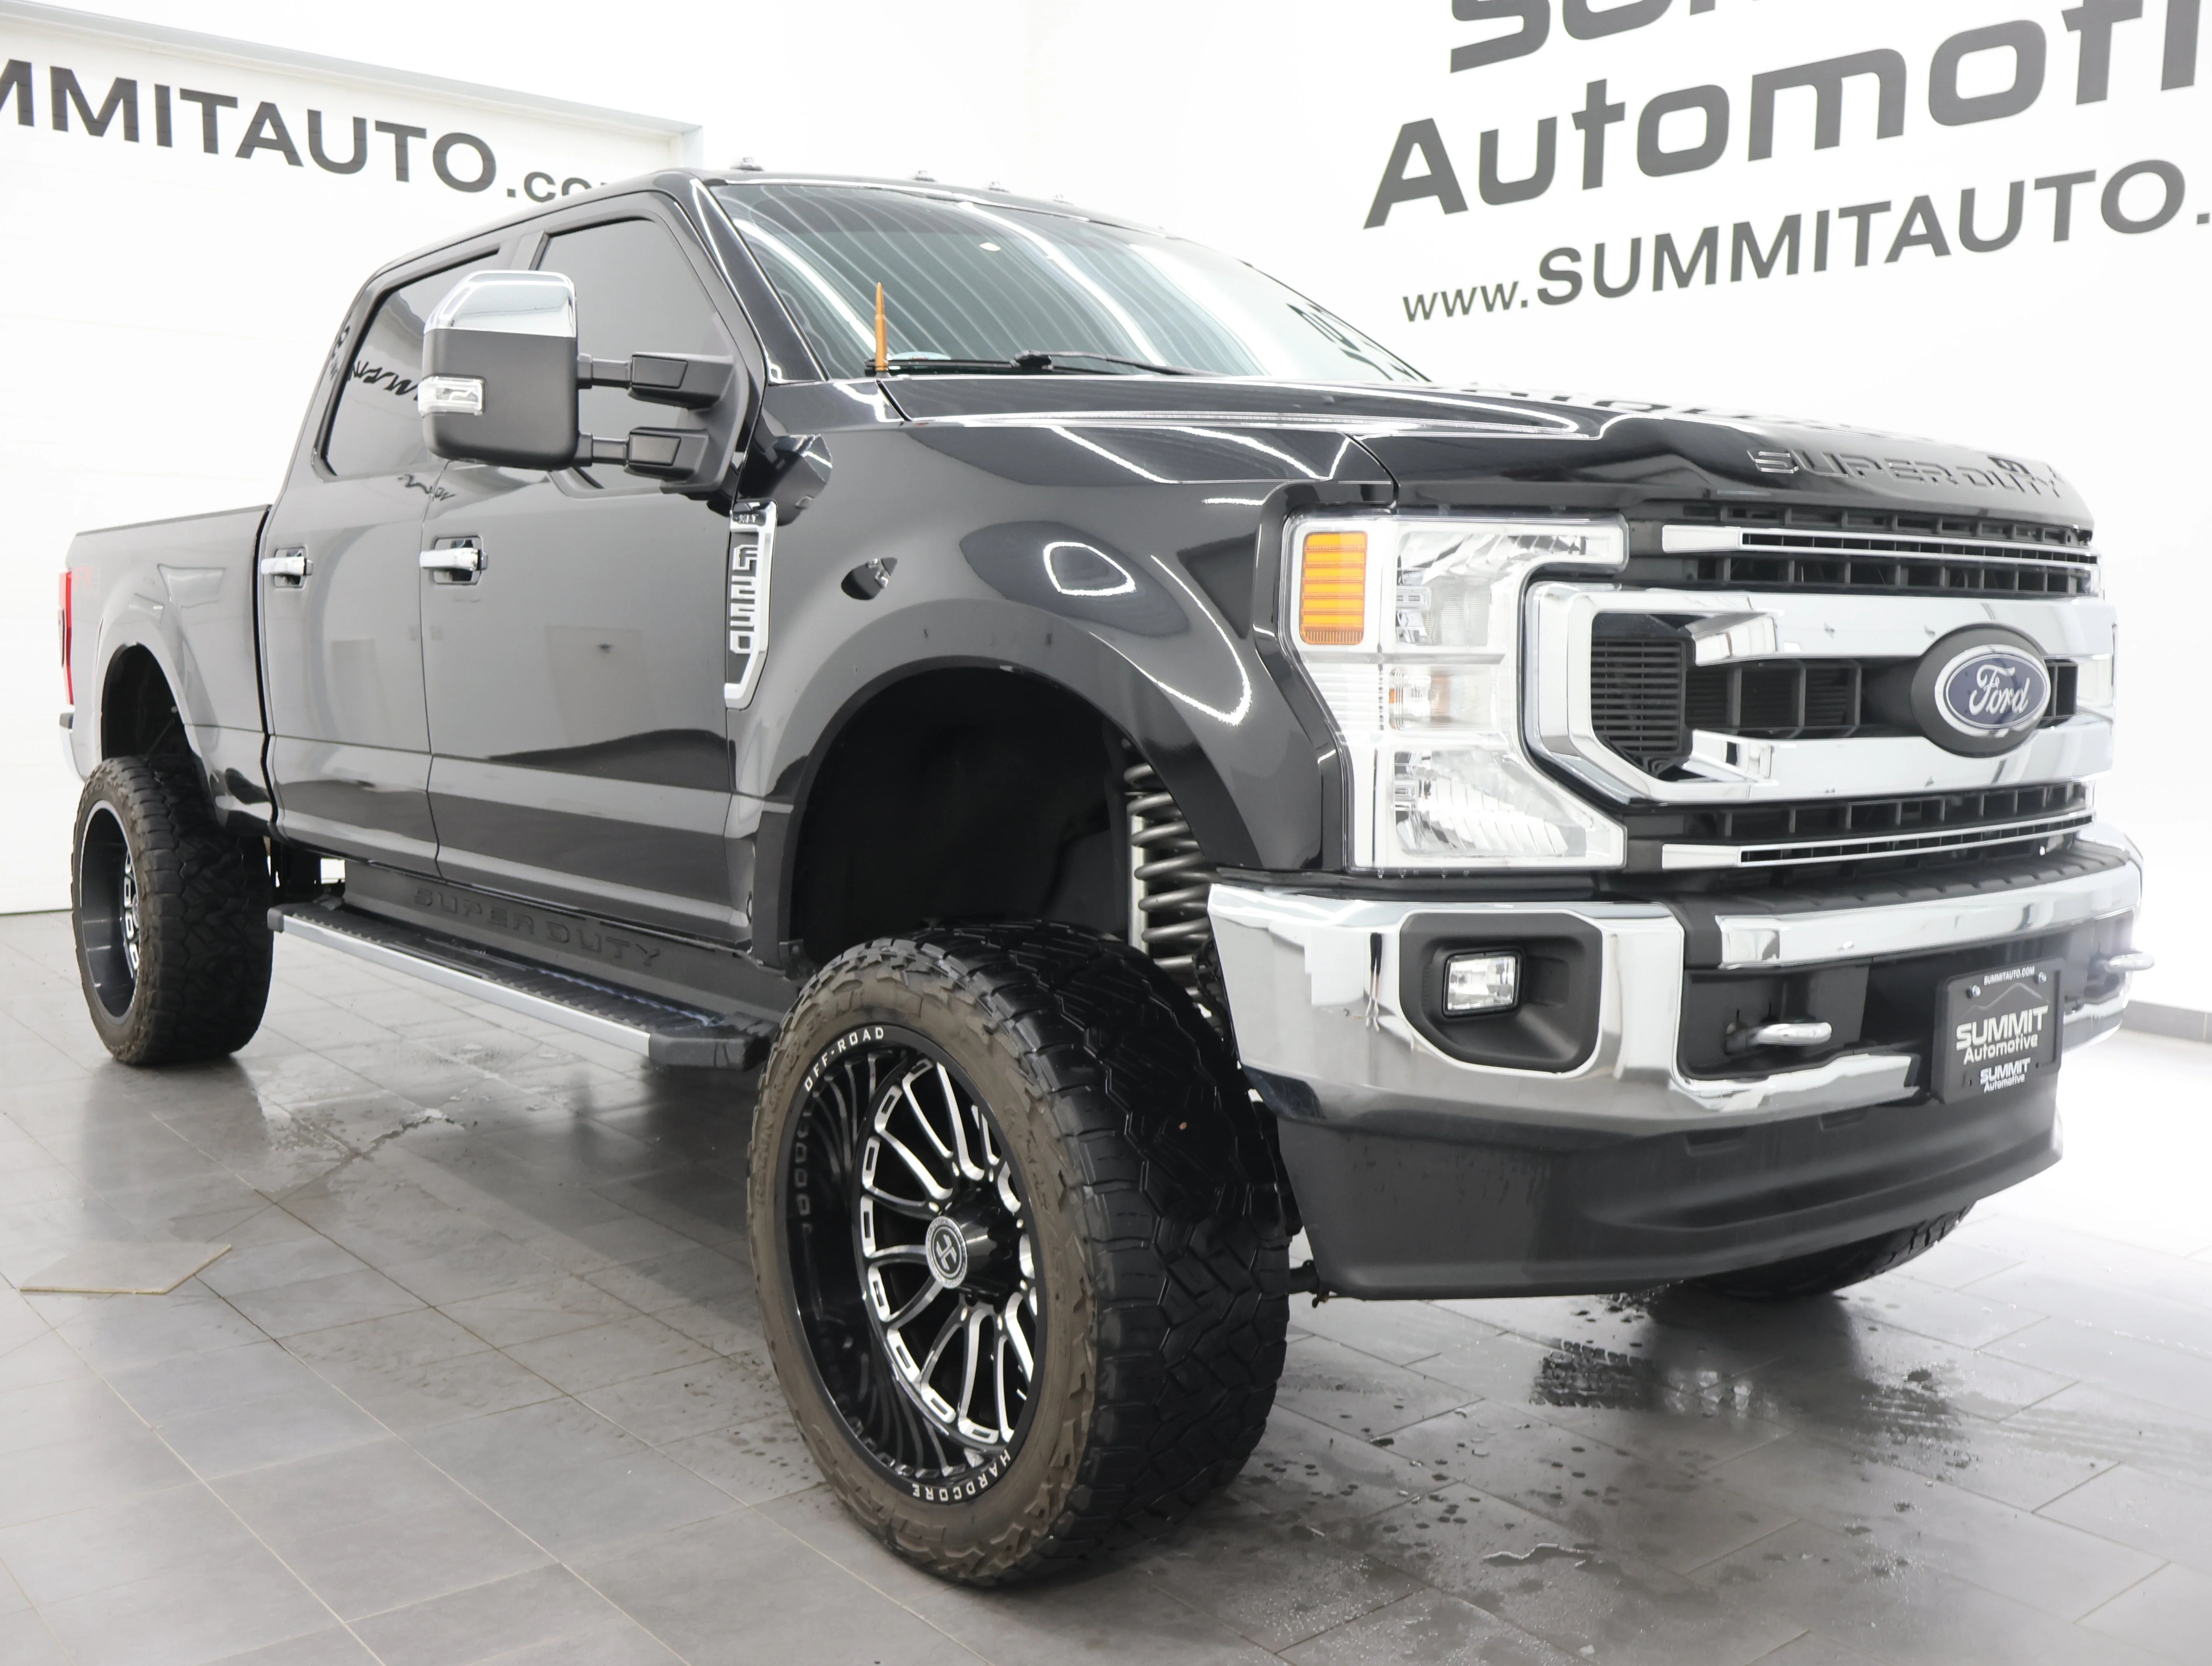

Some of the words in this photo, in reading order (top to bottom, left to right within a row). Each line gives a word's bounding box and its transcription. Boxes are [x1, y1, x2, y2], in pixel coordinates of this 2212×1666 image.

[0, 59, 608, 202] MITAUTO.c
[1402, 159, 2210, 322] www.SUMMITAUTO.
[1969, 664, 2030, 715] Ford
[414, 887, 535, 936] SUPER
[547, 921, 661, 966] DUTY
[1983, 966, 2035, 986] SUMMITAUTO.COM
[1956, 1005, 2049, 1051] SUMMIT
[1963, 1034, 2038, 1065] Automotive
[804, 1026, 884, 1092] OFF-ROAD
[1980, 1057, 2031, 1085] SUMMIT
[1984, 1074, 2025, 1094] Automotive
[911, 1449, 1011, 1502] HARDCORE
